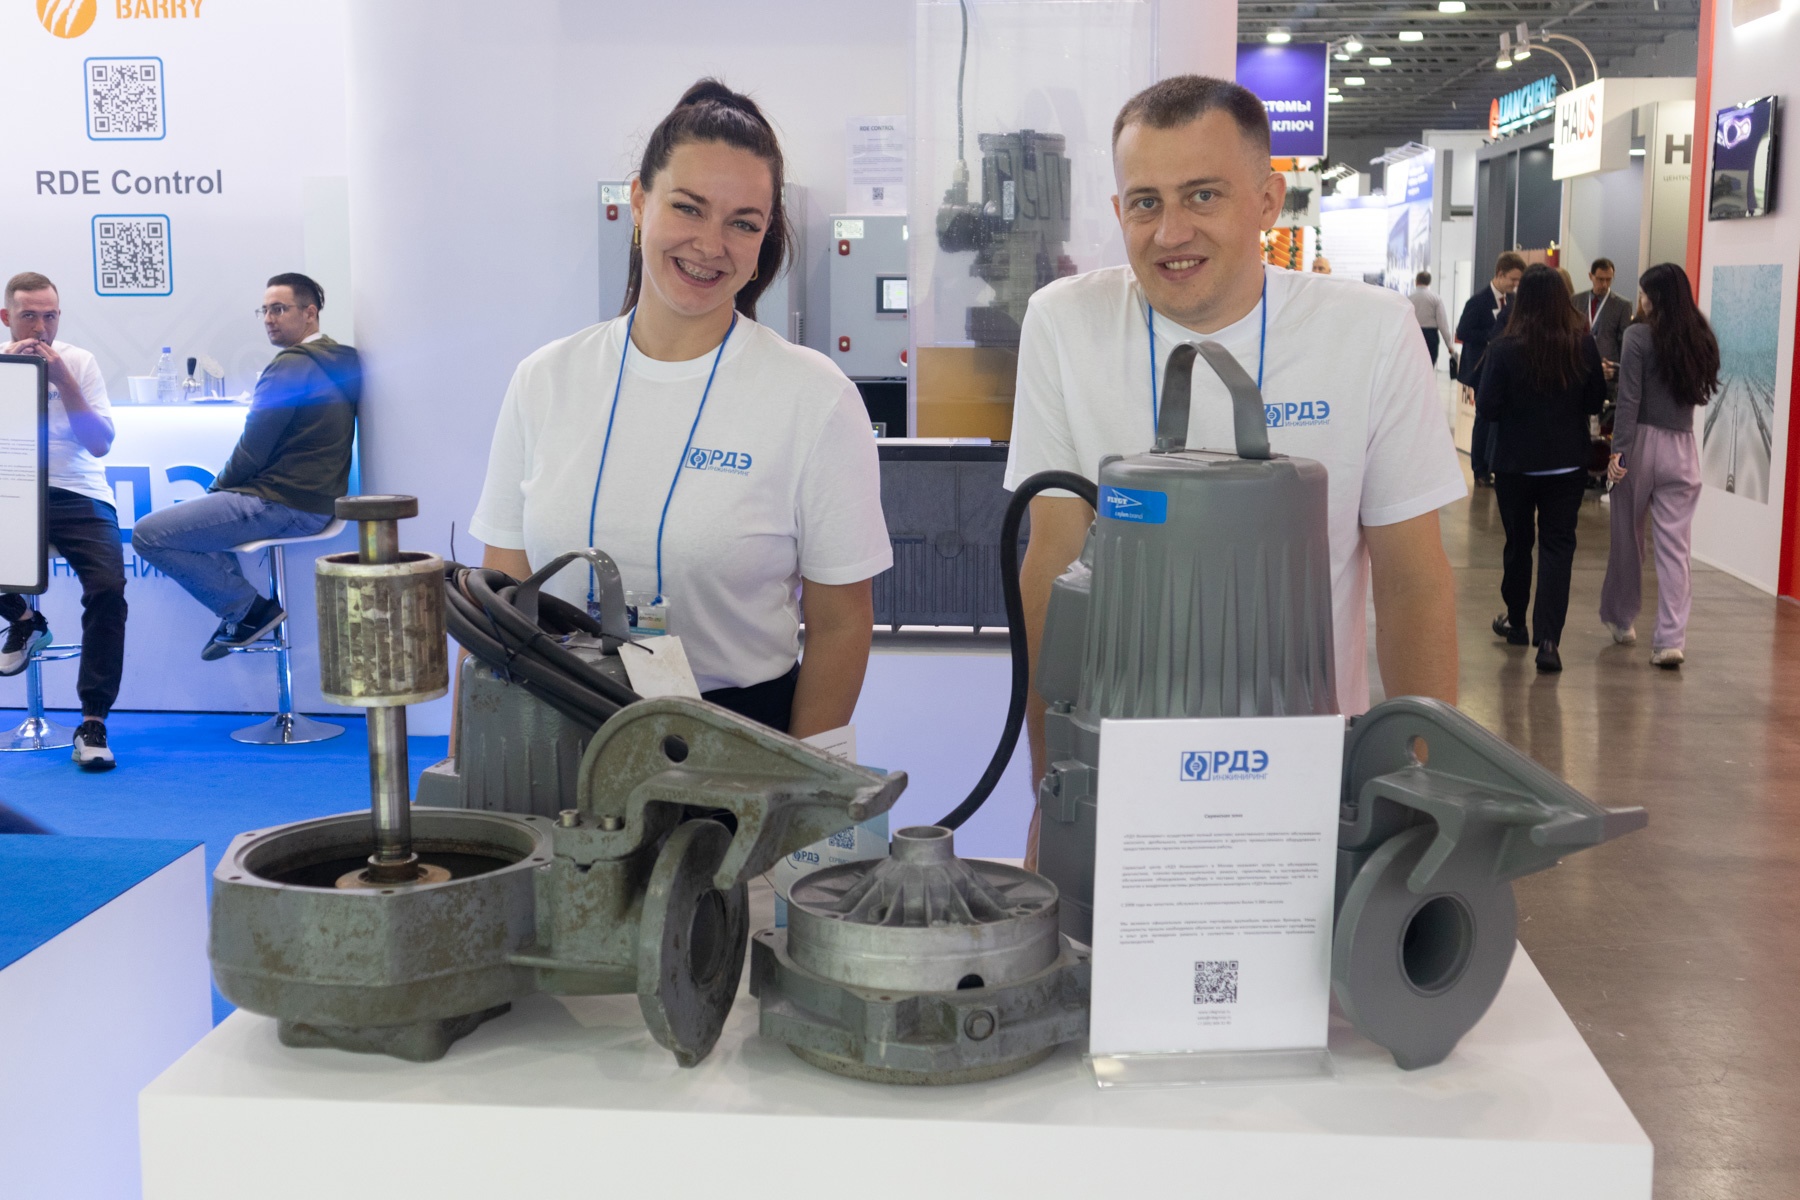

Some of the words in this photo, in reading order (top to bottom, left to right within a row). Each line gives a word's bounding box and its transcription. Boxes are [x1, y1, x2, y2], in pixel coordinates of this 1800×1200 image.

[115, 0, 203, 19] BARRY
[1272, 119, 1315, 132] ключ
[1561, 93, 1596, 145] HAUS
[35, 170, 101, 195] RDE
[111, 169, 223, 195] Control
[1285, 400, 1330, 421] РДЭ
[709, 449, 753, 470] РДЭ
[1213, 750, 1269, 774] РДЭ
[1212, 772, 1268, 781] ИНЖИНИРИНГ
[802, 850, 820, 863] РДЭ
